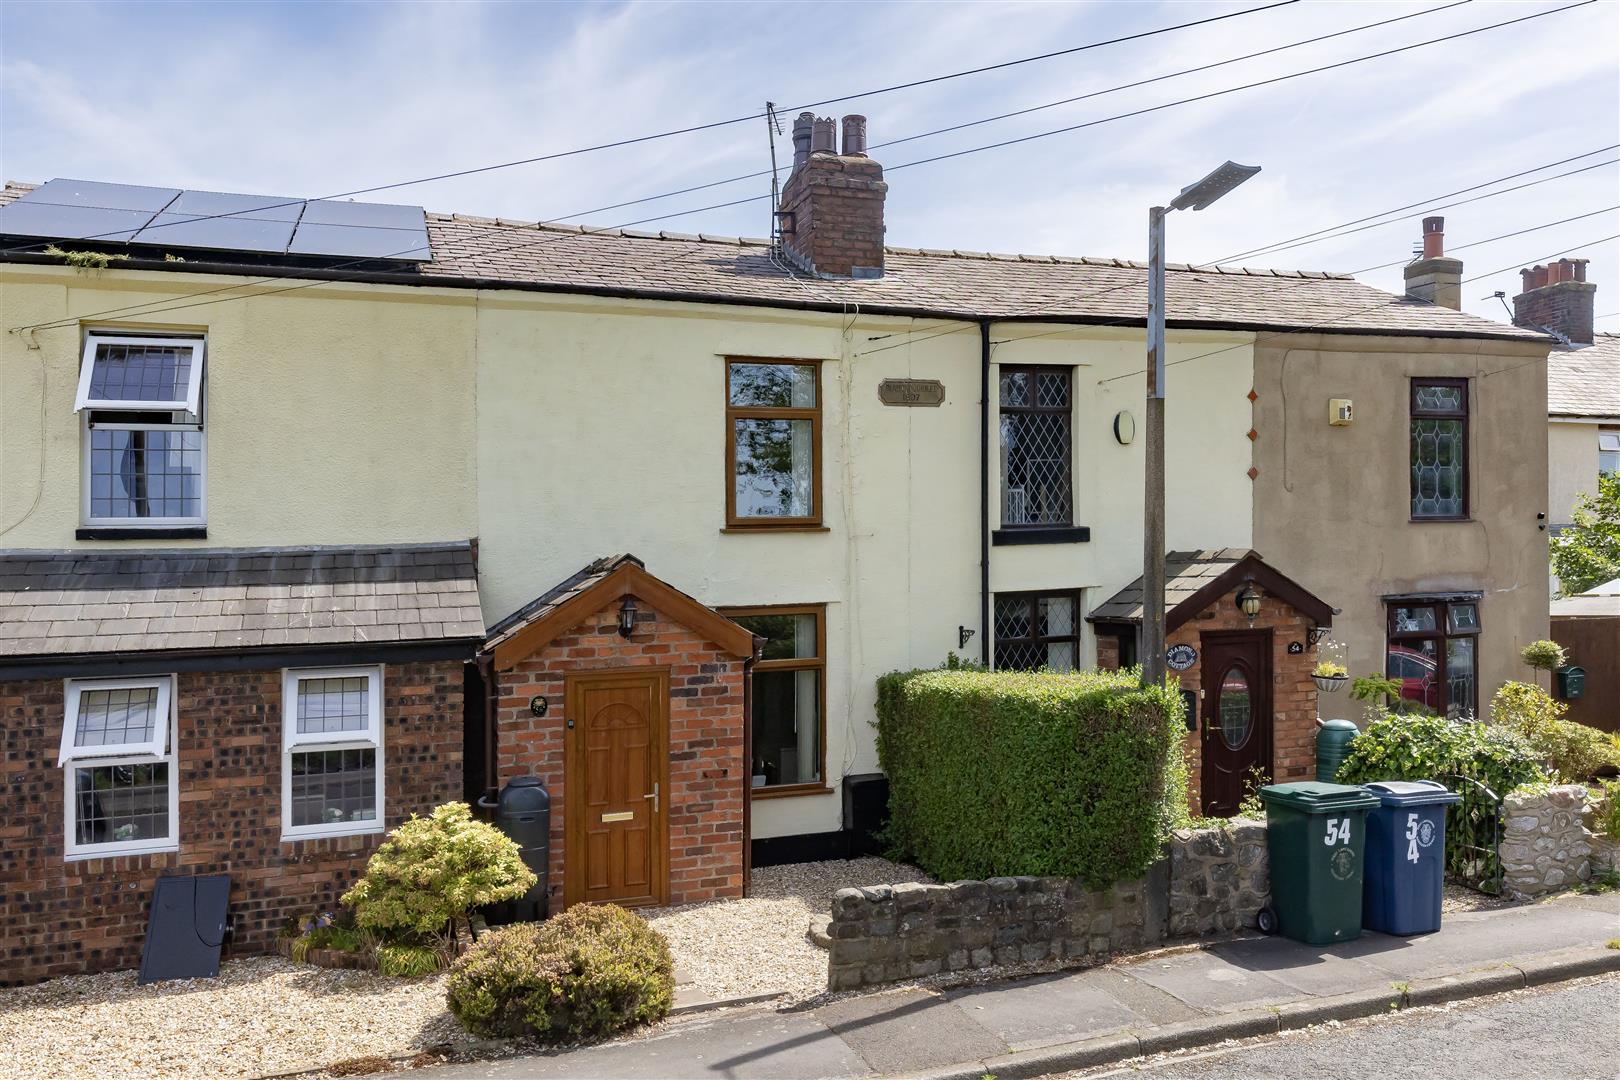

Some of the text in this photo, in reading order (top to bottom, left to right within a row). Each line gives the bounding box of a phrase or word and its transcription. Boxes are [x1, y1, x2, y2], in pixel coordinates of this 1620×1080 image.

[1167, 645, 1196, 657] DIAMOND
[1168, 657, 1195, 669] COTTAGE
[1324, 818, 1351, 846] 54
